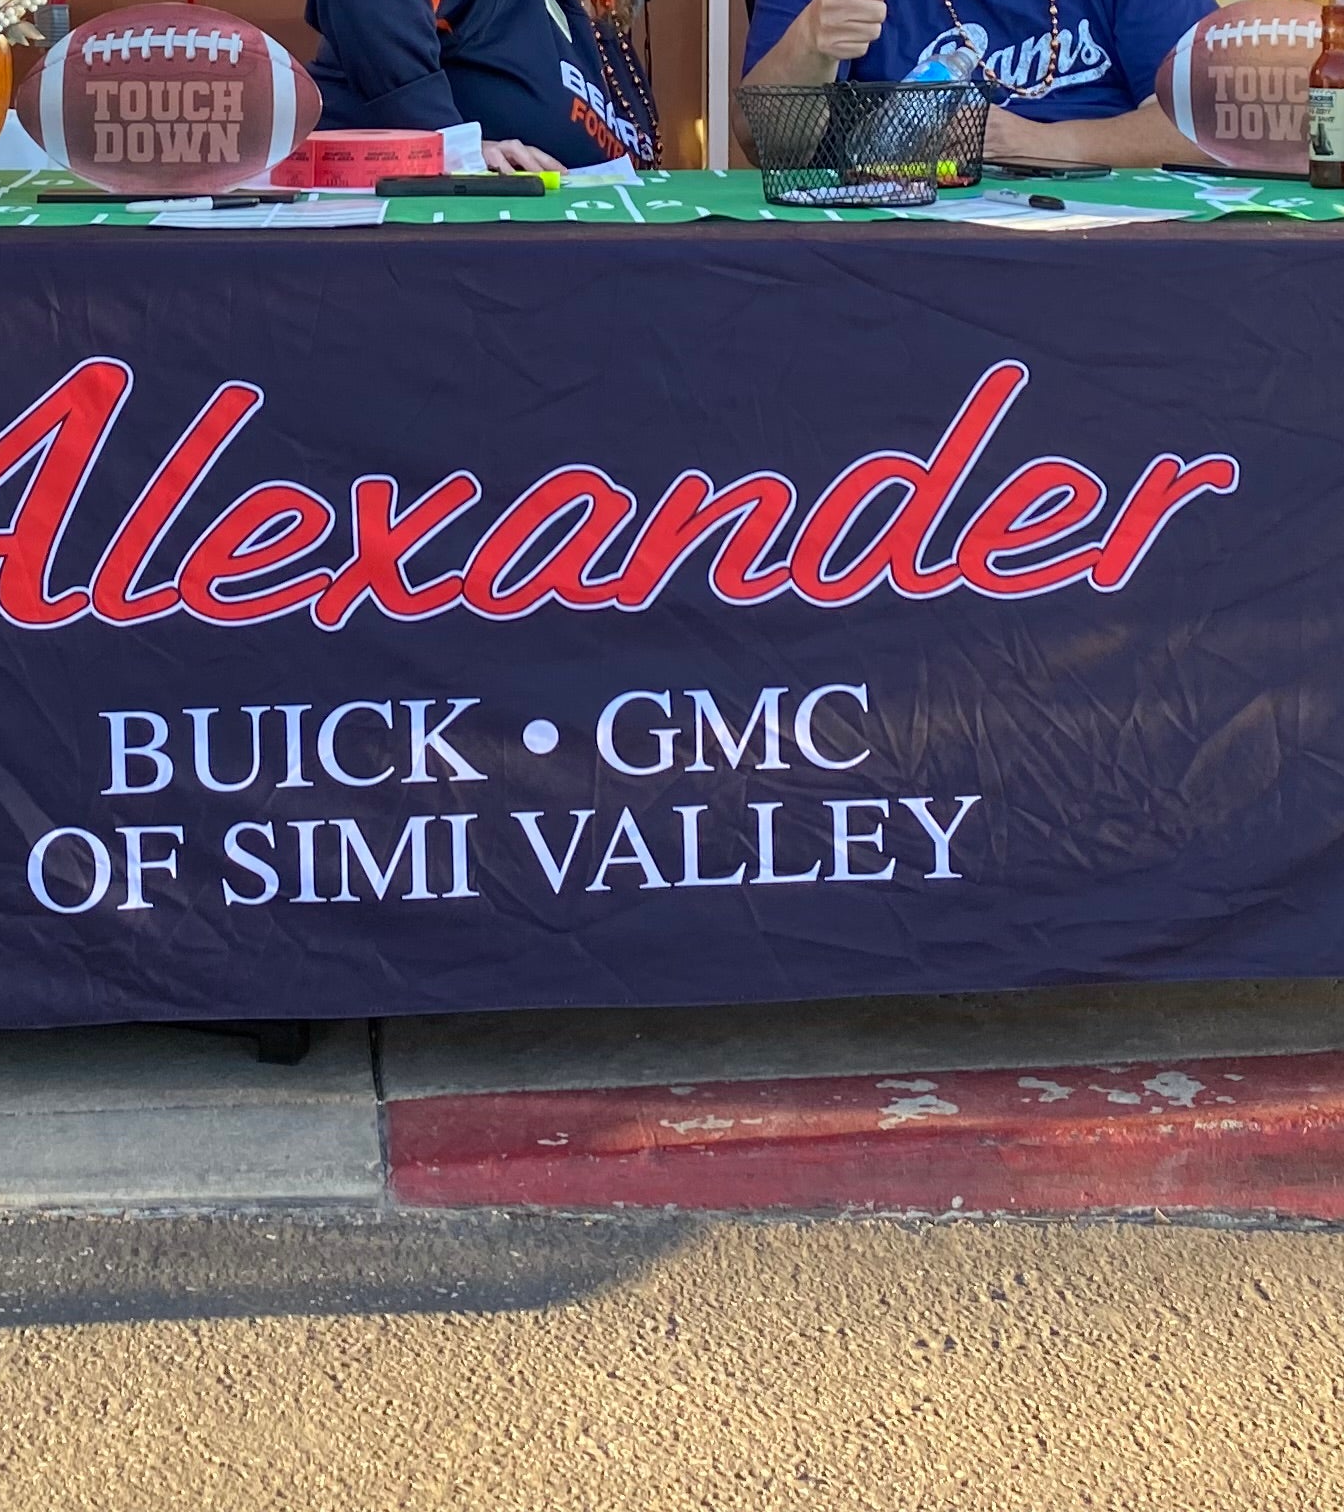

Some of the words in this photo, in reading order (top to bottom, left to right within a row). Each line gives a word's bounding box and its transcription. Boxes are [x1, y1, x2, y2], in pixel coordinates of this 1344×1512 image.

[84, 80, 245, 122] TOUCH
[92, 122, 242, 164] DOWN
[1215, 103, 1310, 142] DOW
[97, 696, 489, 797] BUICK
[592, 682, 874, 776] GMC
[25, 821, 183, 916] OF
[222, 812, 474, 908] SIMI
[509, 792, 985, 898] VALLEY
